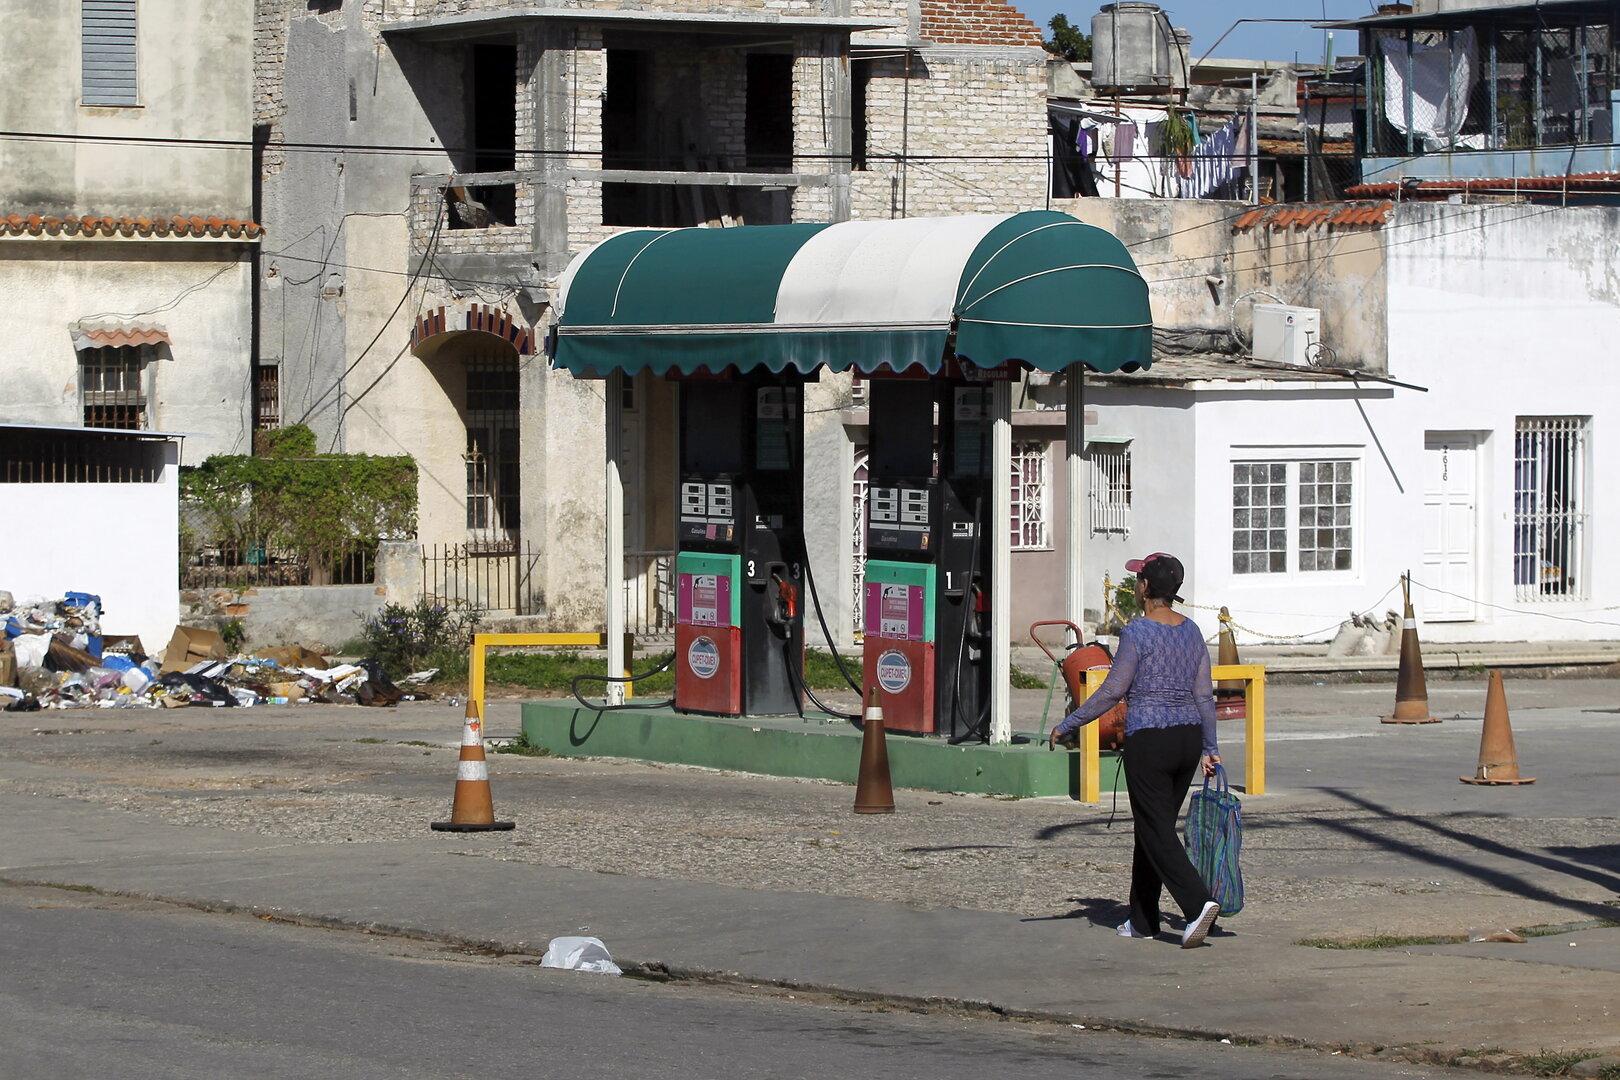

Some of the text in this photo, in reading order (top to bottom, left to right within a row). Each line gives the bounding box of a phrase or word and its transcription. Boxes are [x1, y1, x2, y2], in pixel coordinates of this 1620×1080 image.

[747, 560, 755, 577] 3
[793, 562, 801, 579] 3
[945, 571, 952, 590] 1
[866, 588, 871, 597] 2
